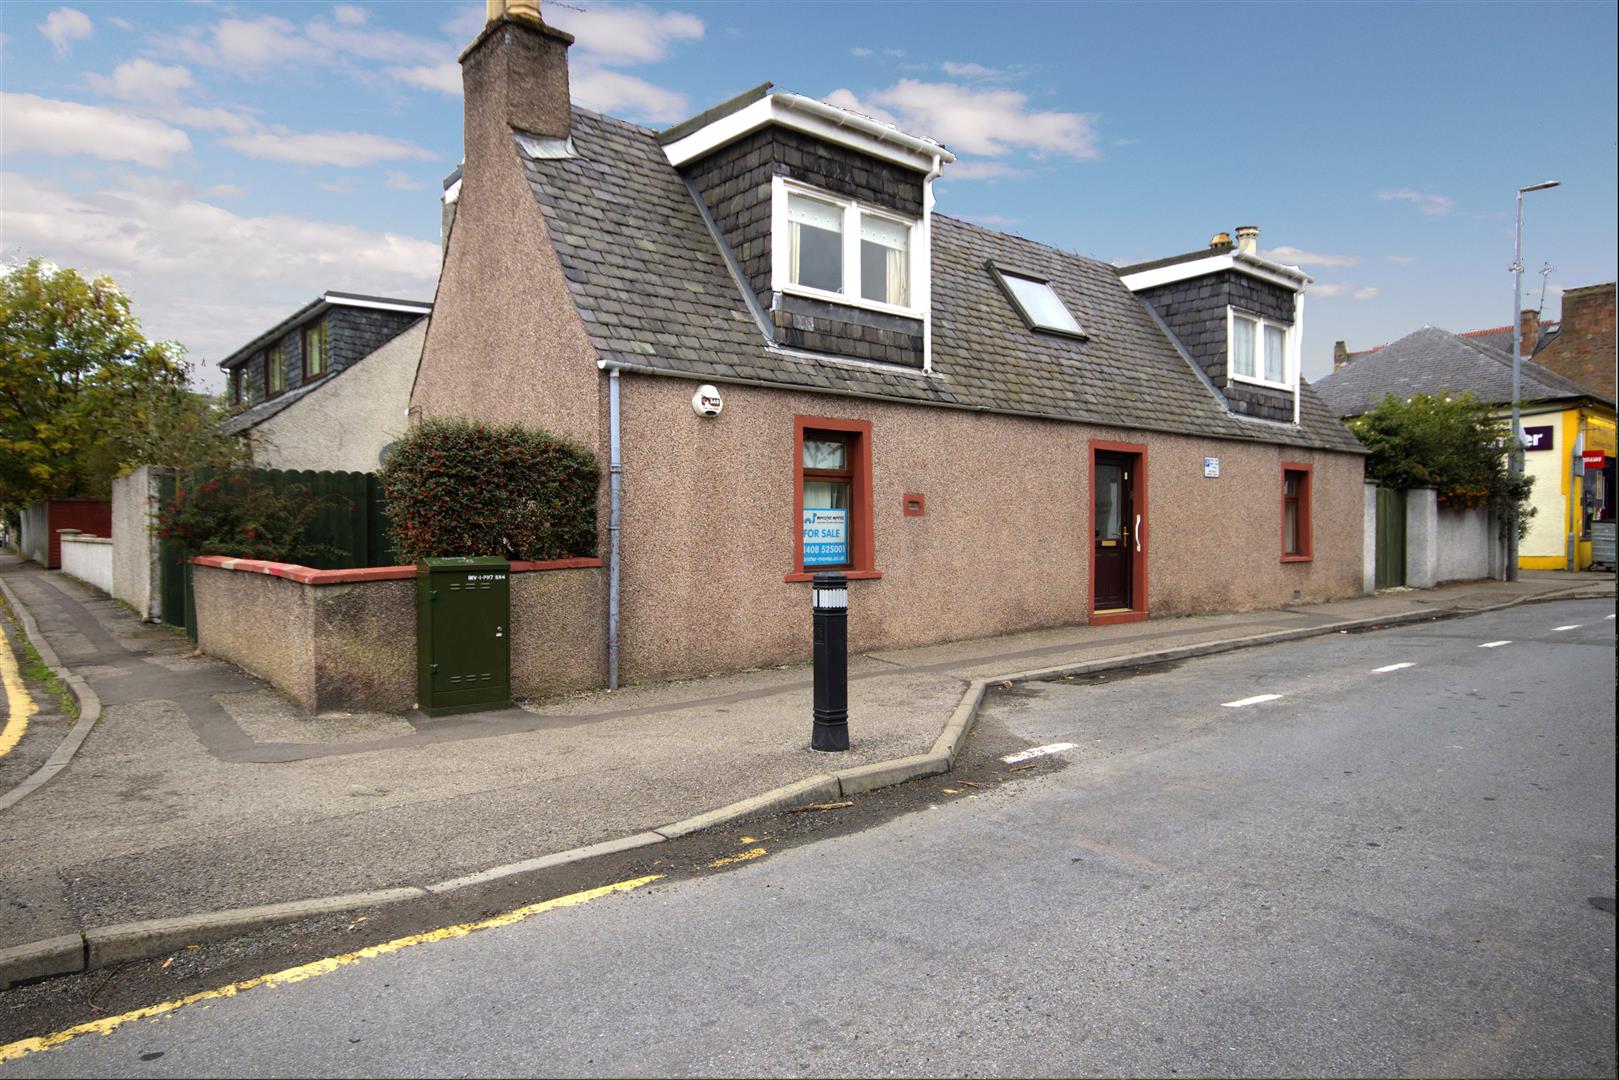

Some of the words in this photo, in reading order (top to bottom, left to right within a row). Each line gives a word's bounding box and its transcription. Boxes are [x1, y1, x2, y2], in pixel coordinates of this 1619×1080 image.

[803, 529, 819, 538] FOR
[821, 529, 840, 538] SALE
[821, 545, 845, 554] 525001
